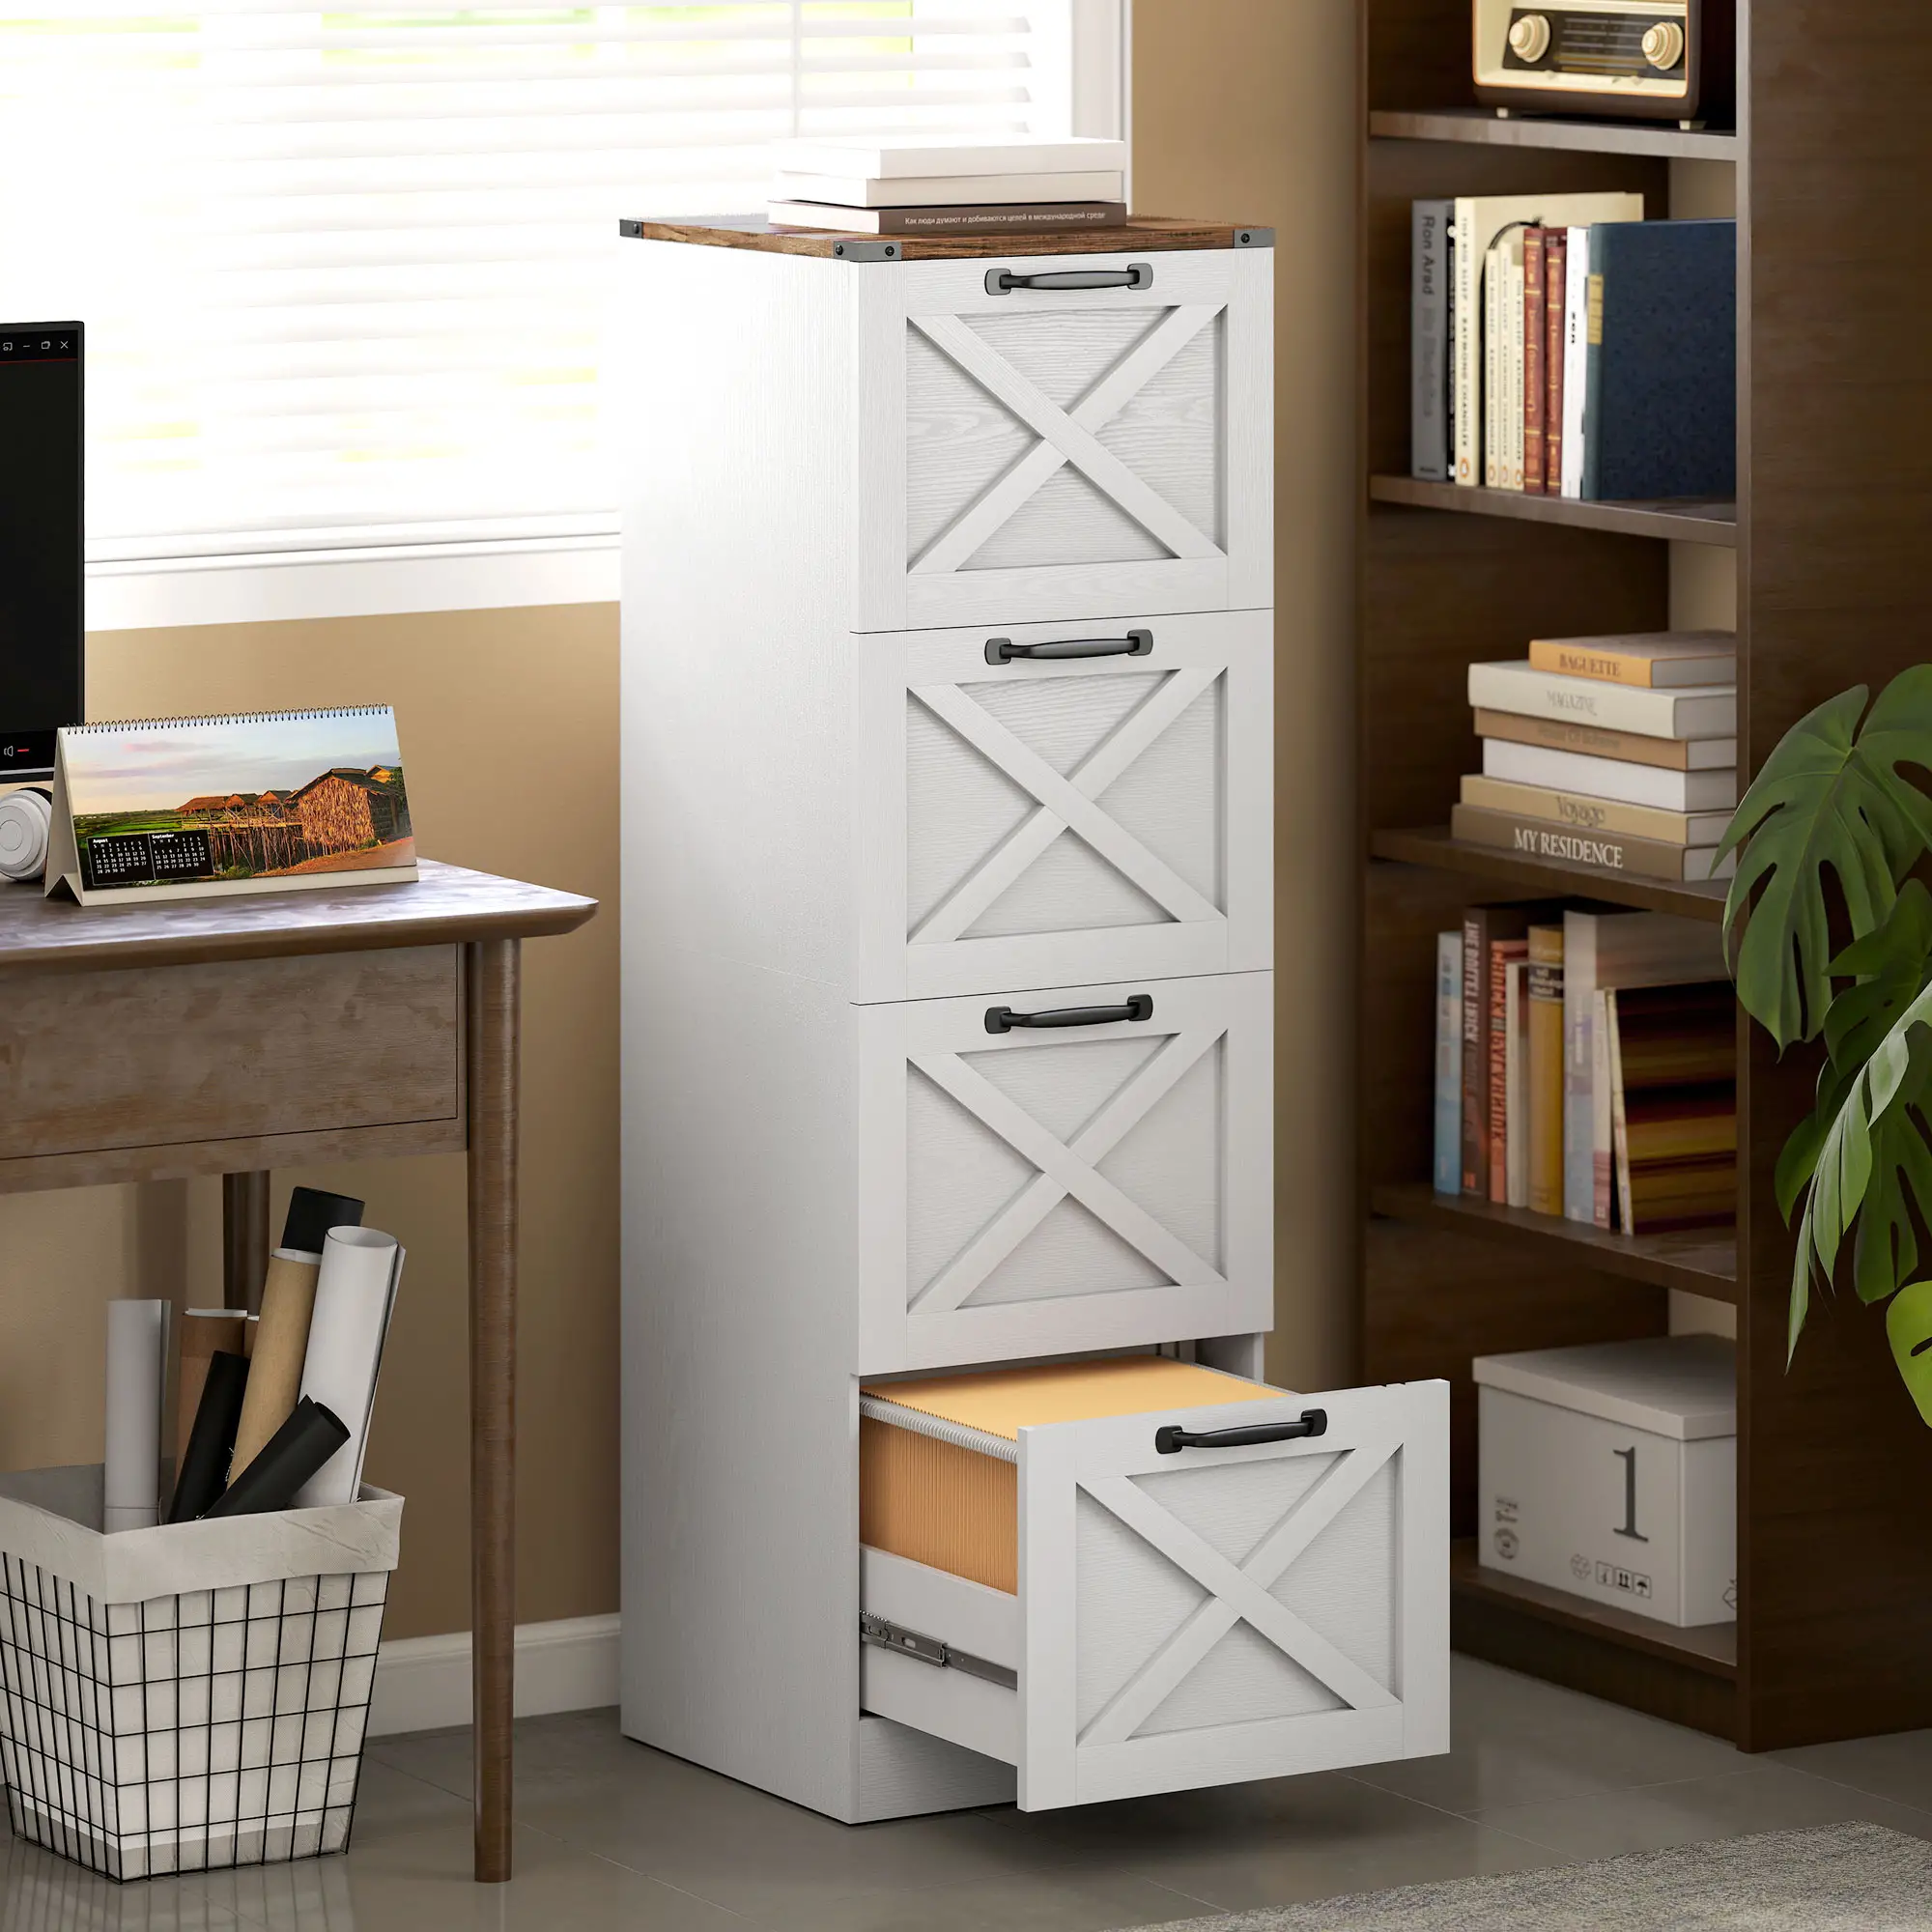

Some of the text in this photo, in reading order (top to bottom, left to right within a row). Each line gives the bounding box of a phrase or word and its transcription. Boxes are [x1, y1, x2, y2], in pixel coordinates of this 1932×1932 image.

[936, 216, 961, 225] думают
[967, 214, 1006, 224] добиваются
[1007, 213, 1026, 222] целей
[1033, 212, 1085, 221] международной
[1086, 212, 1106, 220] среде
[1421, 215, 1436, 250] Ron
[1421, 255, 1436, 295] Arad
[1559, 652, 1621, 678] BAGUETTE
[1556, 795, 1606, 827] Voyage
[1514, 827, 1623, 869] MY RESIDENCE
[1612, 1446, 1649, 1544] 1
